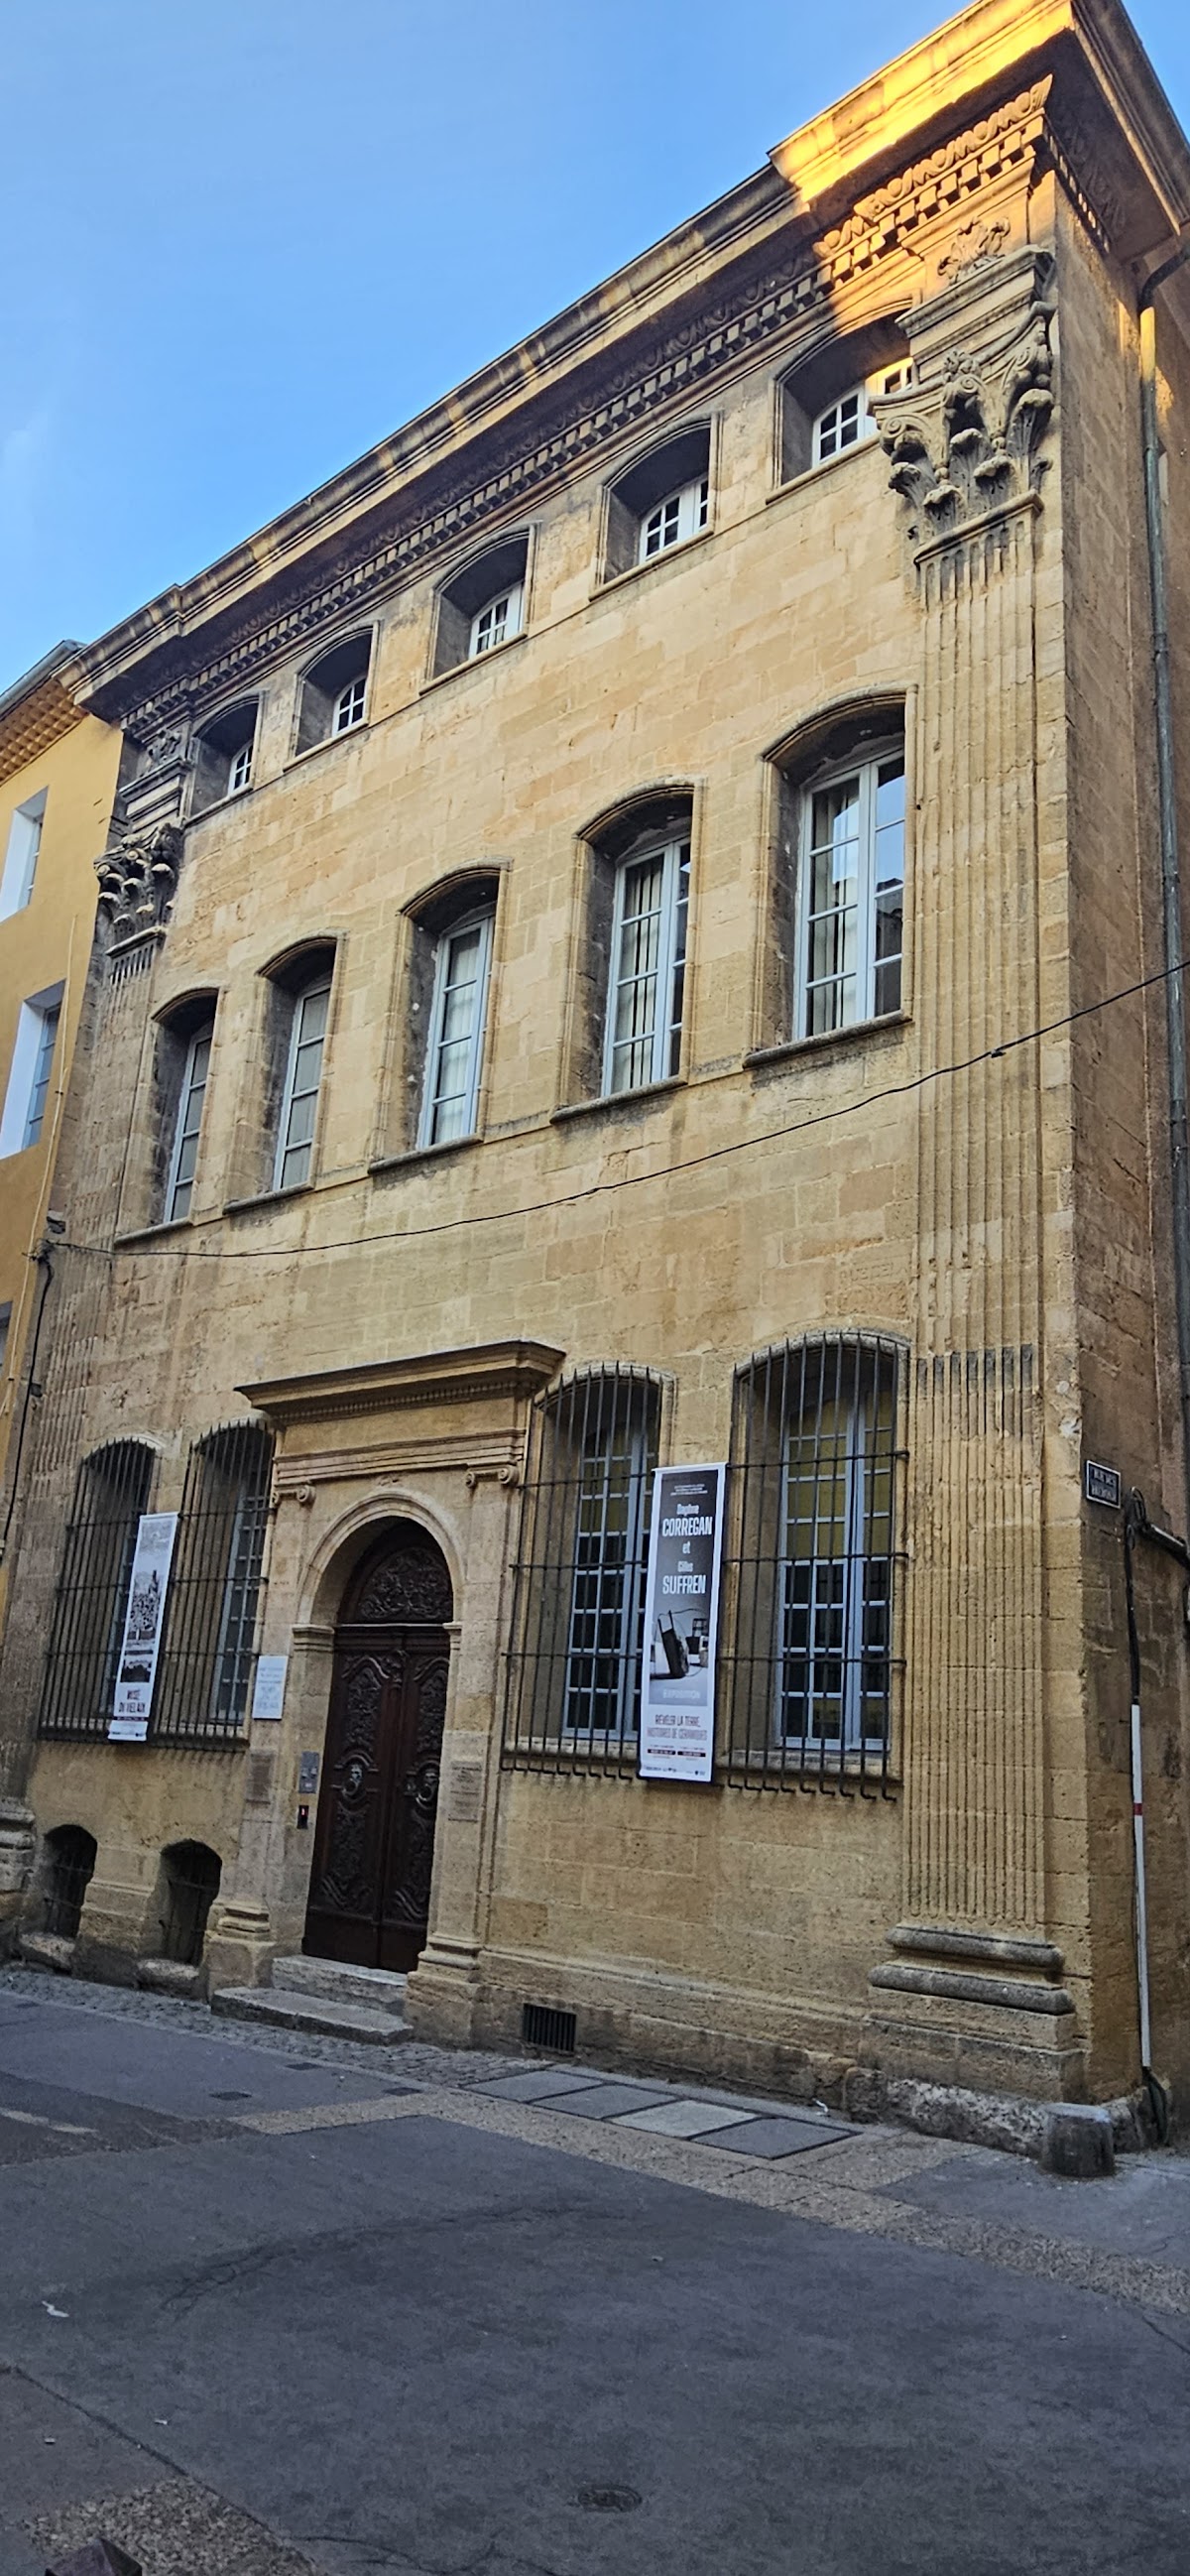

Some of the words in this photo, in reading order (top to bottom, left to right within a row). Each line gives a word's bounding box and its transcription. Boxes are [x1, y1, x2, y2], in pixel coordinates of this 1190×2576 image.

[662, 1517, 712, 1536] CORREGAN
[682, 1540, 690, 1553] et
[662, 1574, 706, 1594] SUFFREN
